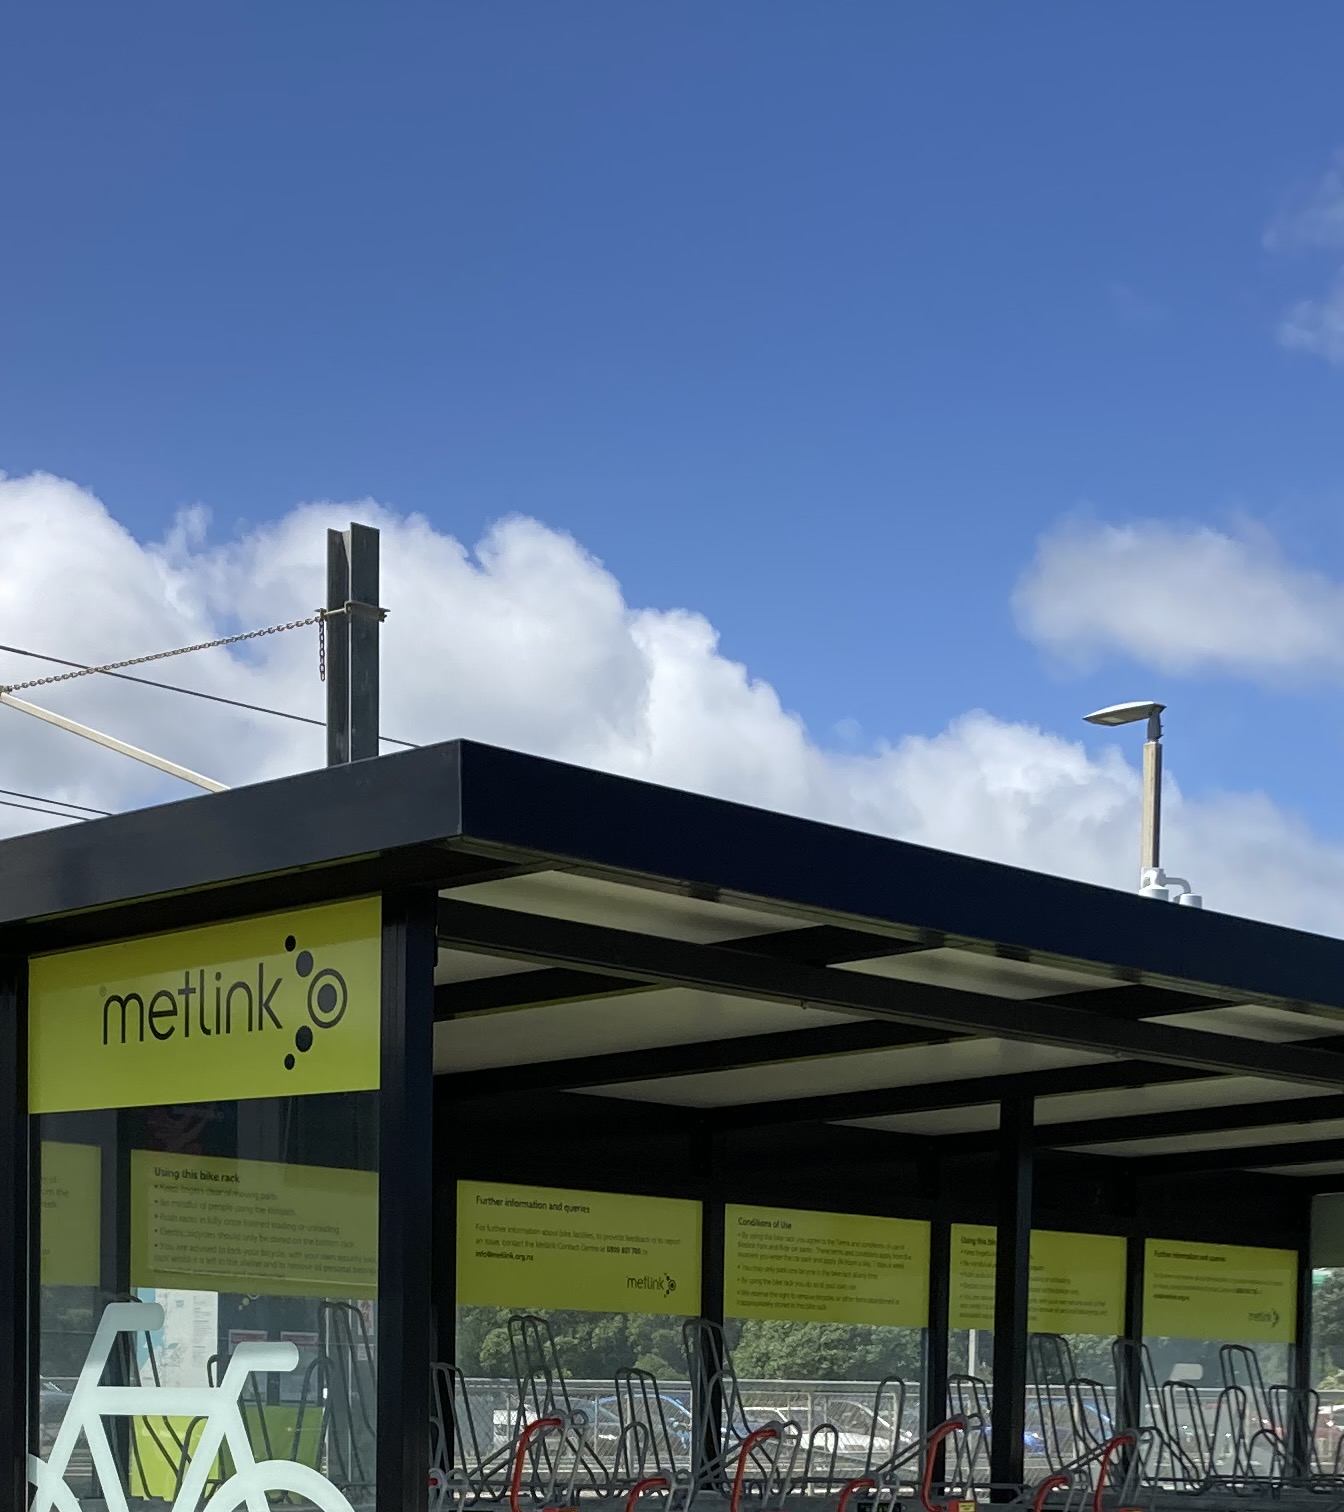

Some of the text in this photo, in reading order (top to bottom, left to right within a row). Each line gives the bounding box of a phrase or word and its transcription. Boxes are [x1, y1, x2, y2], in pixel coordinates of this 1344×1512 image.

[103, 962, 283, 1045] metlink
[154, 1167, 240, 1183] Using this bike rack
[476, 1195, 590, 1214] Further information and queries
[626, 1276, 664, 1290] metlink
